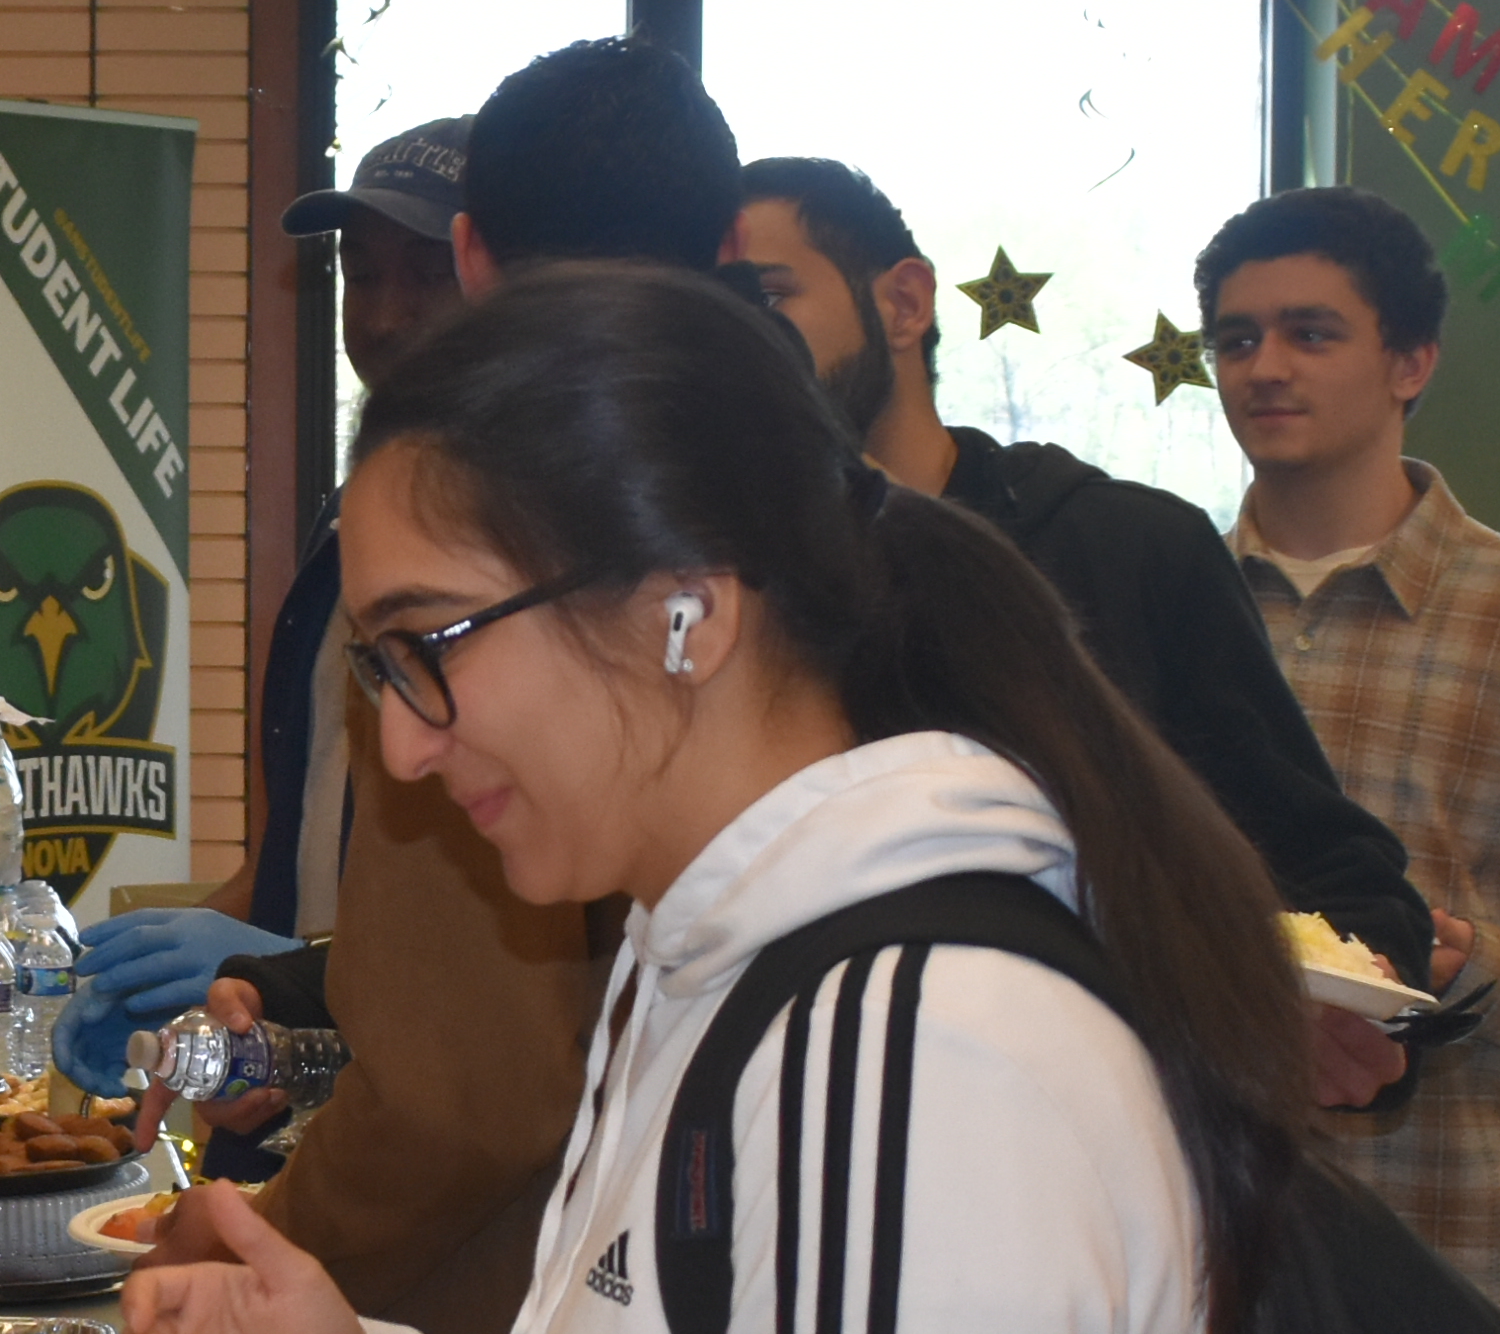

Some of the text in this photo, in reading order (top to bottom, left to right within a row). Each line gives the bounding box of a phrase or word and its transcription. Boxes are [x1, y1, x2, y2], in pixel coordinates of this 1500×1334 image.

[108, 368, 185, 499] LIFE
[16, 754, 167, 822] THAWKS
[585, 1267, 635, 1307] adidas
